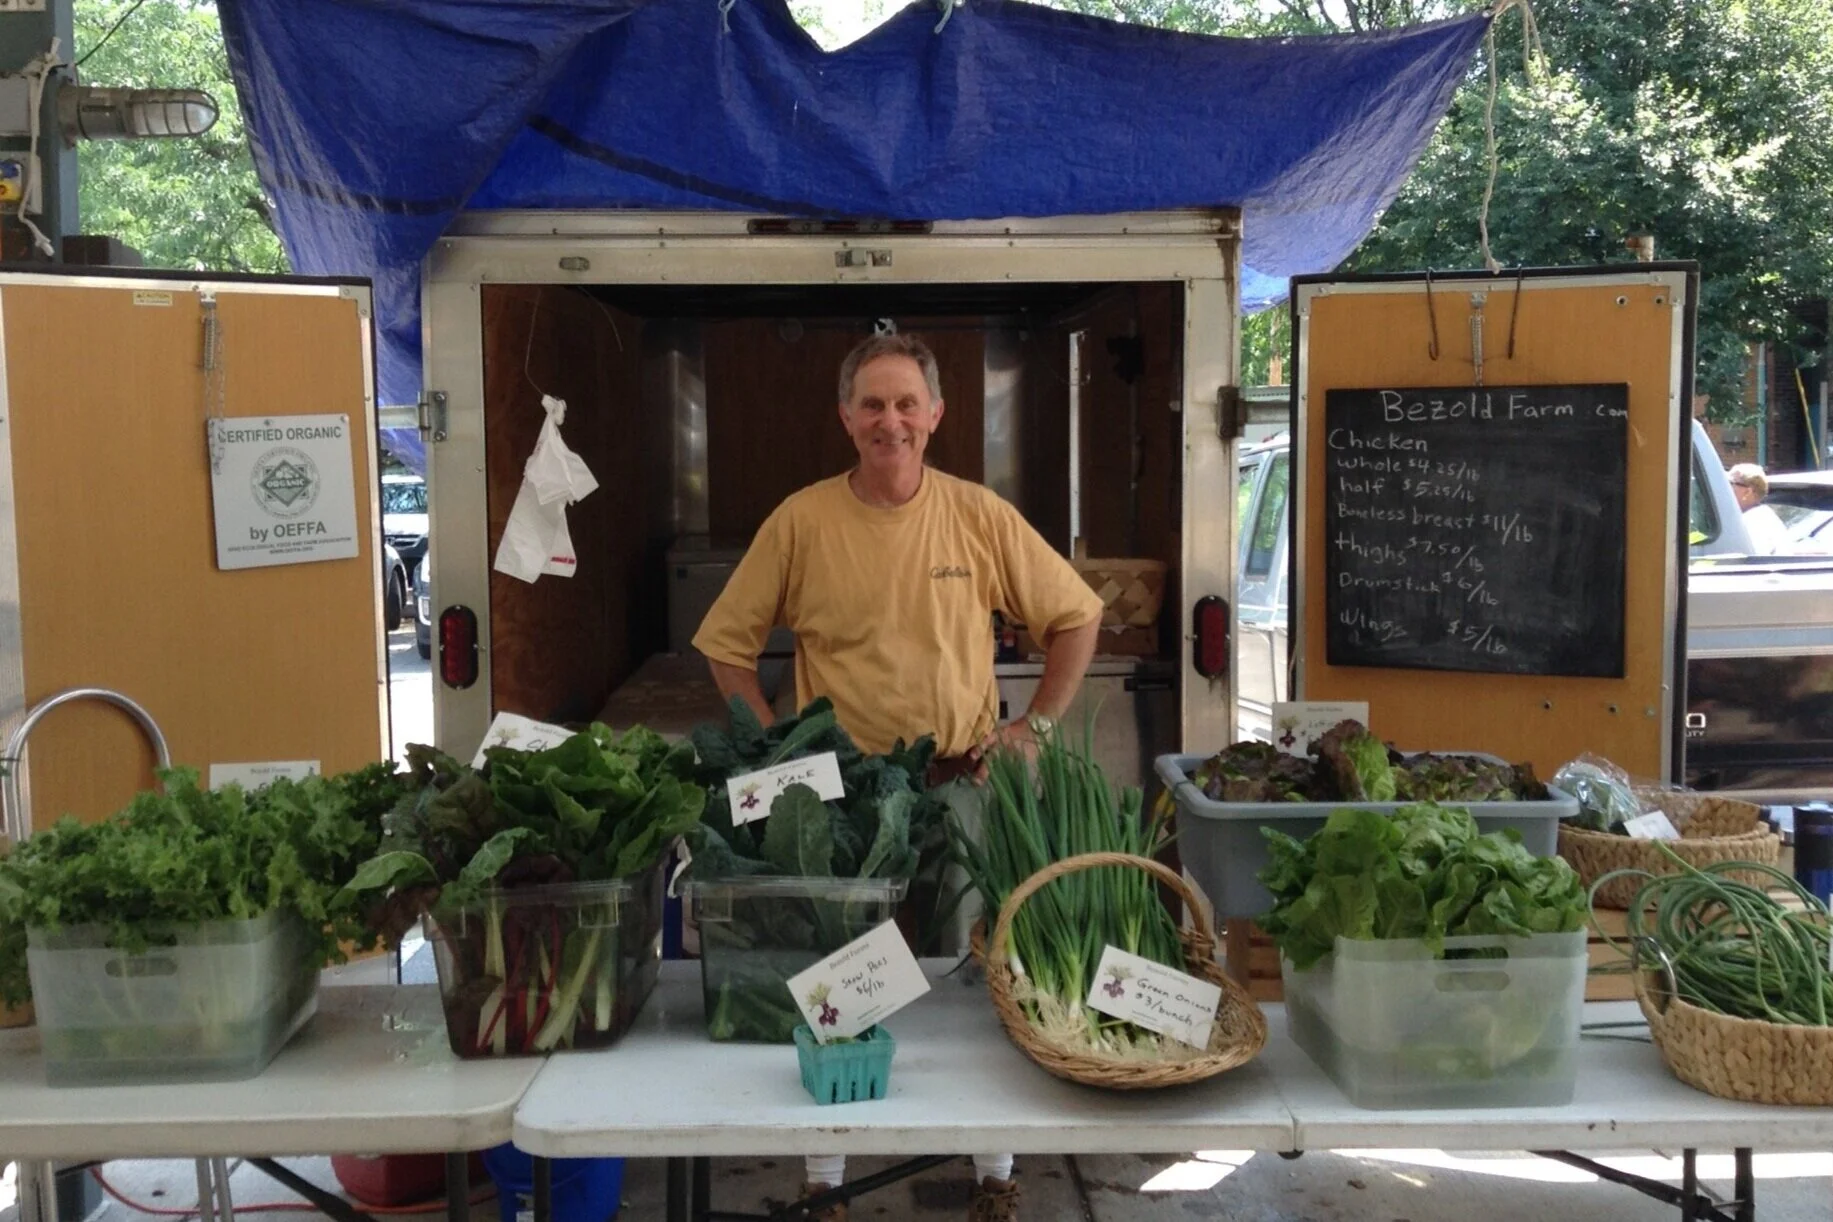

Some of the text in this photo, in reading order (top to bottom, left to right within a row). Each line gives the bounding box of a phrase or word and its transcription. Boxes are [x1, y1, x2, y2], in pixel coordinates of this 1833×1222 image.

[1380, 391, 1493, 422] Bezold
[1508, 394, 1574, 420] Farm
[218, 426, 342, 443] CERTIFIED ORGANIC
[1328, 428, 1428, 451] Chicken
[1340, 477, 1385, 493] half
[1412, 507, 1474, 528] breast
[250, 521, 327, 542] by OEFFA
[776, 768, 815, 786] KALE
[841, 972, 863, 989] Snow
[1137, 978, 1212, 1013] Green Onions
